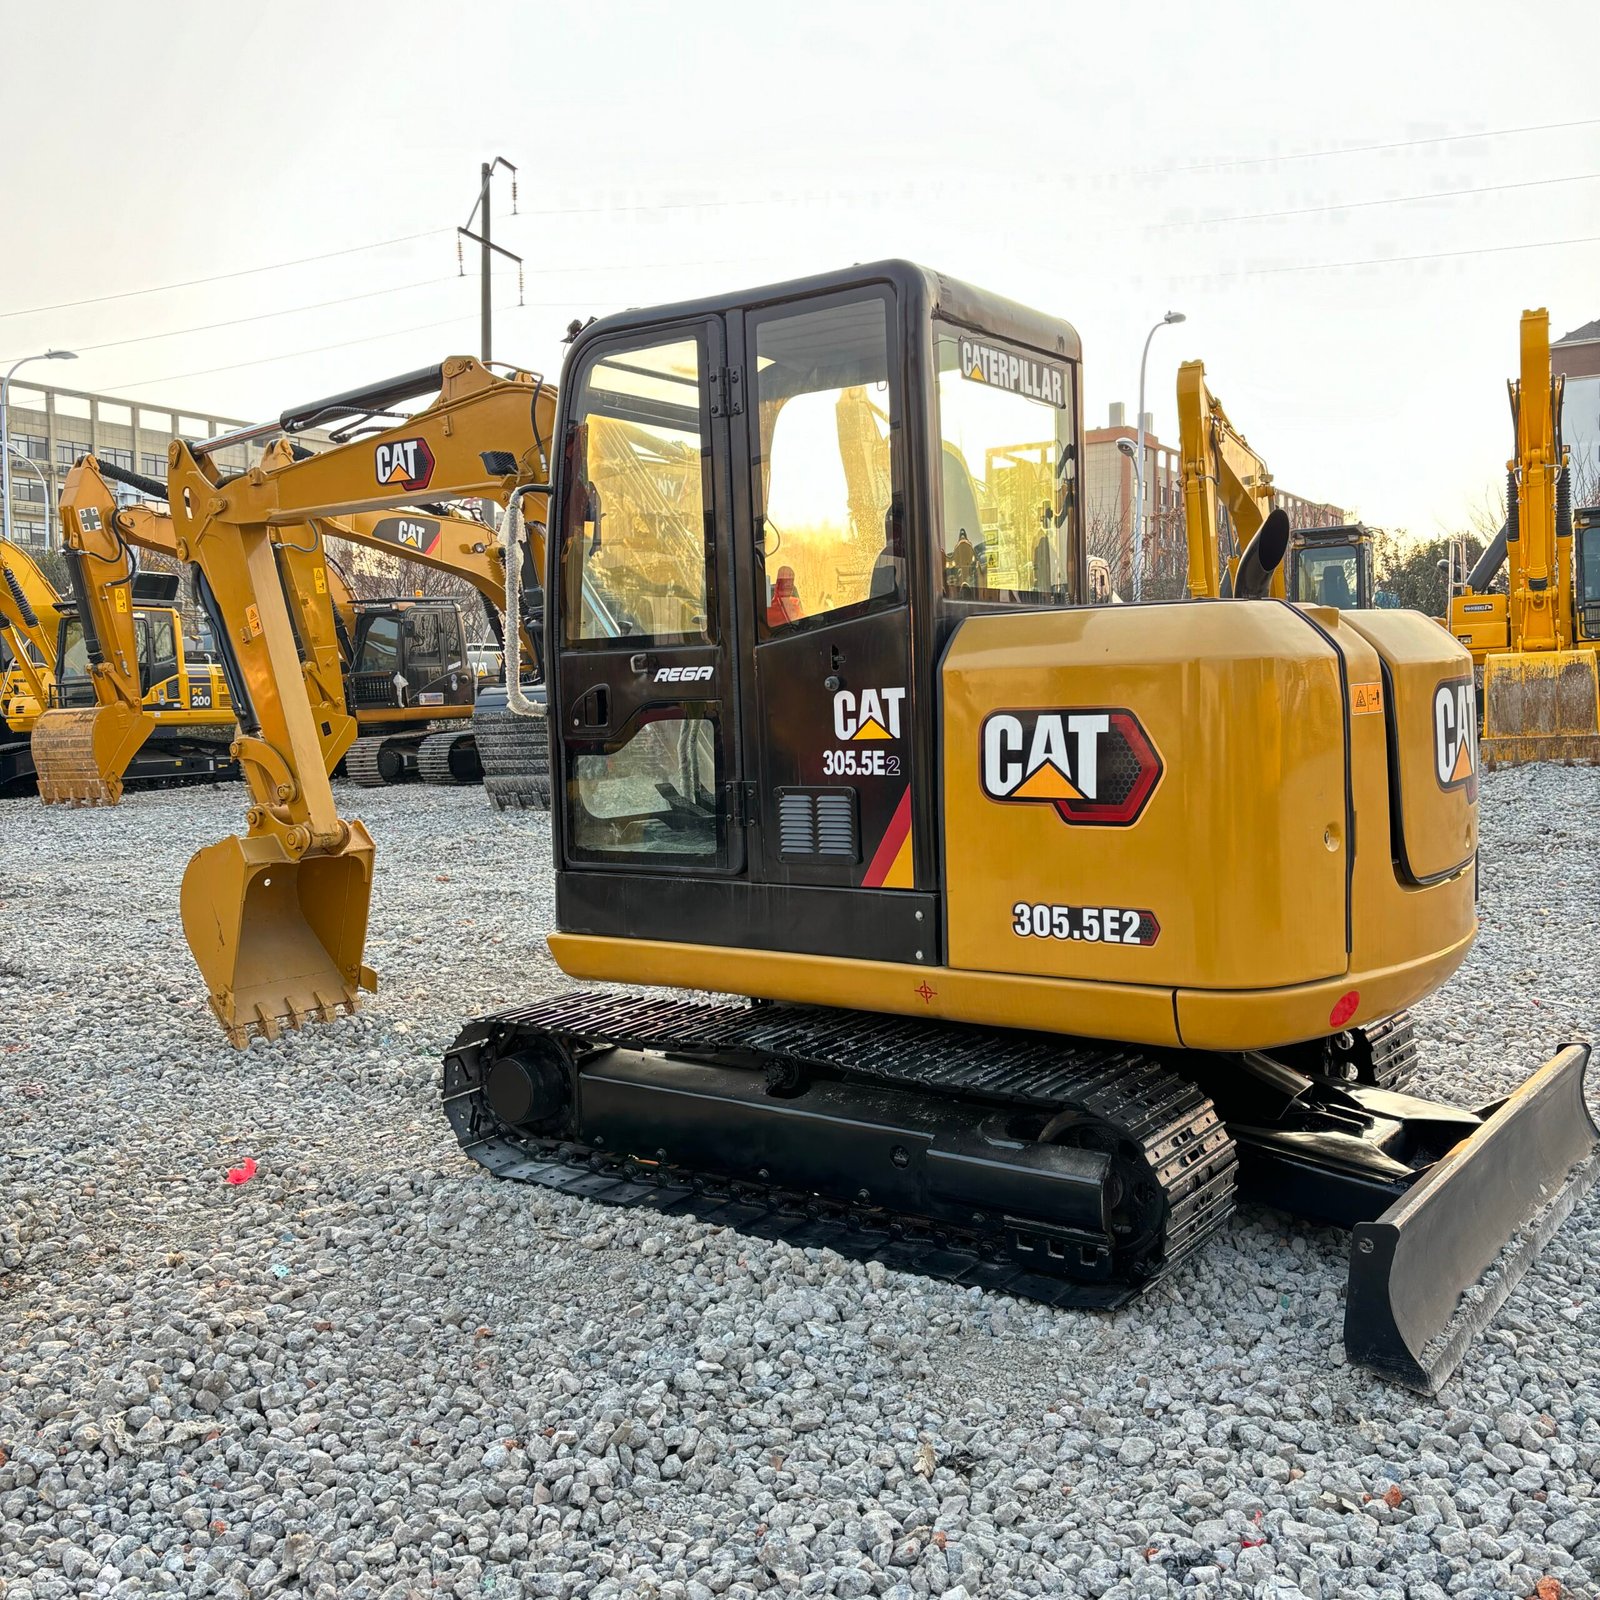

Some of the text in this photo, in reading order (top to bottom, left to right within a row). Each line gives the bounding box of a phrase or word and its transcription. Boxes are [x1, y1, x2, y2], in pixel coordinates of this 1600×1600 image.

[962, 341, 1062, 406] CATERPILLAR
[376, 441, 418, 484] CAT
[398, 520, 425, 549] CAT
[192, 687, 203, 695] PC
[653, 666, 714, 682] REGA
[192, 696, 211, 706] 200
[833, 687, 906, 741] CAT
[1435, 684, 1475, 783] CAT
[822, 750, 901, 776] 305.5E2
[984, 714, 1110, 800] CAT
[1013, 903, 1141, 945] 305.5E2
